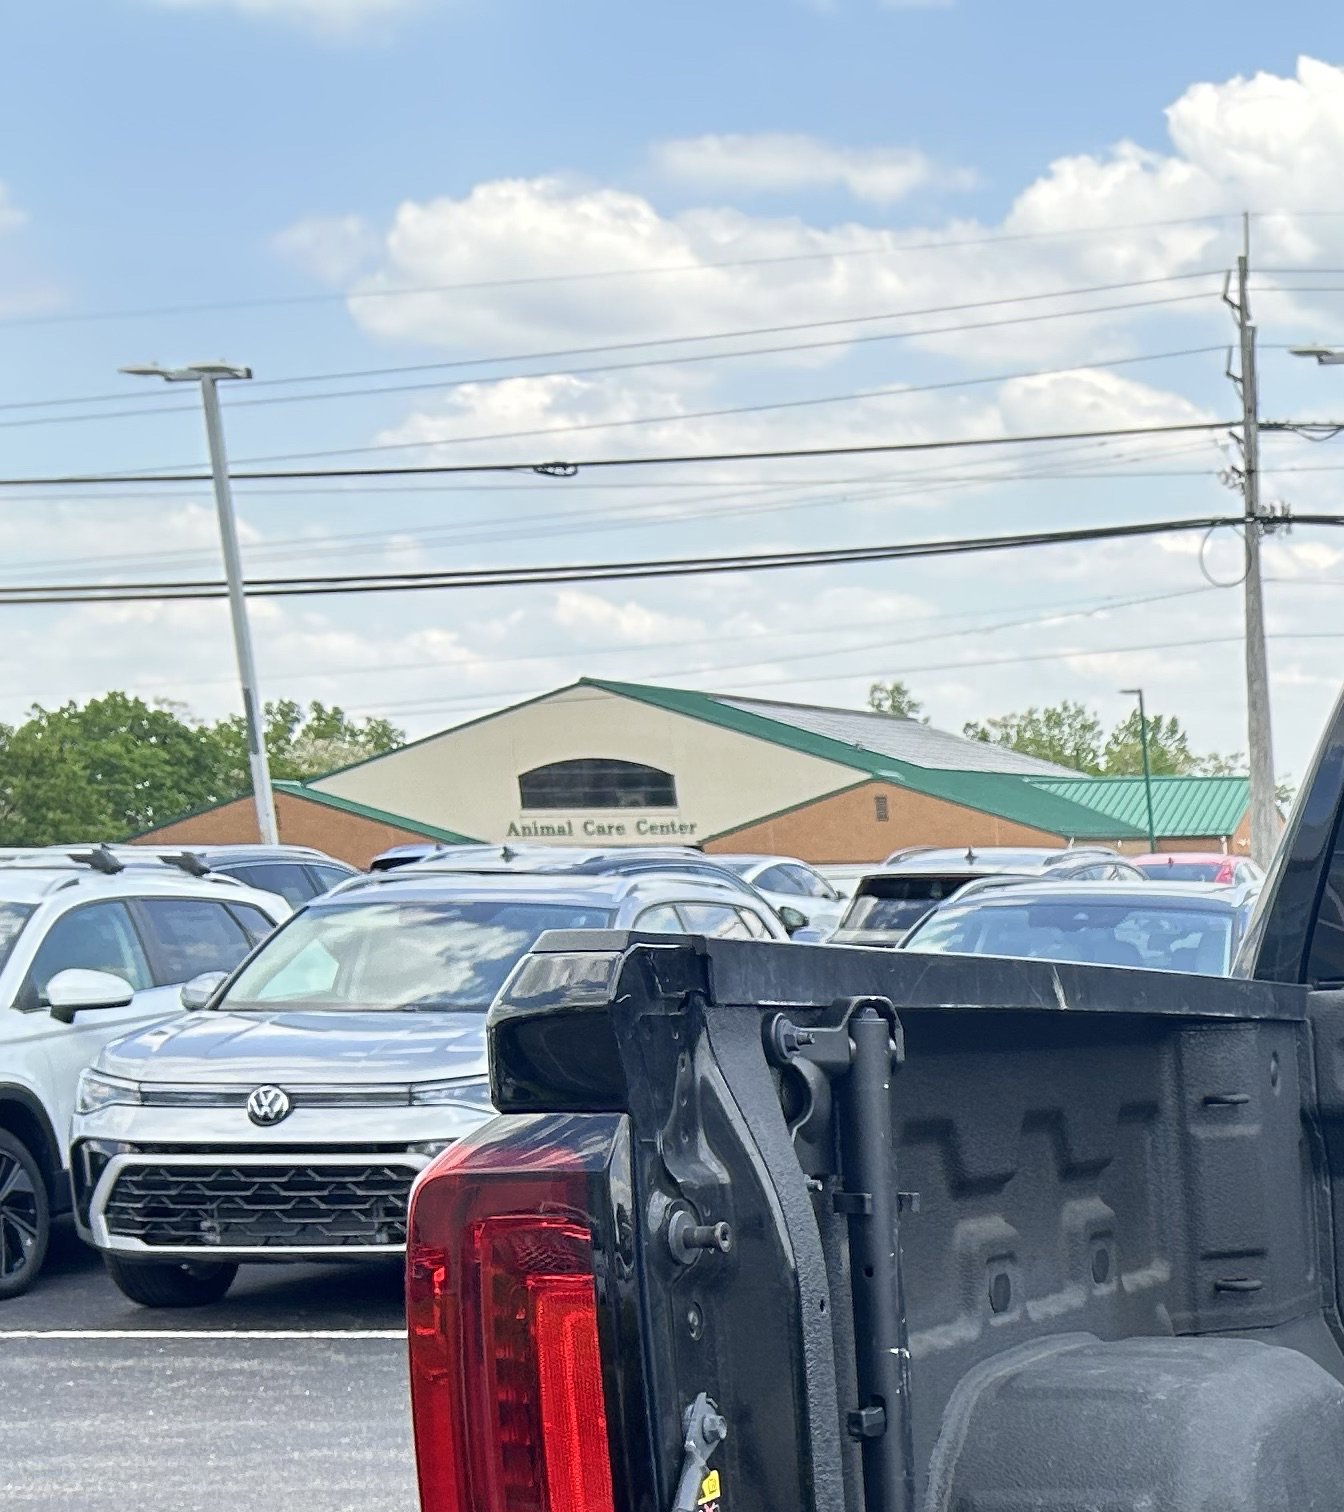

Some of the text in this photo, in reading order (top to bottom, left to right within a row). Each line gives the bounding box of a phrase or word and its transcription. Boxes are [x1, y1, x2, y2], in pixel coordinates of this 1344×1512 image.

[506, 818, 698, 837] Animal Care Center
[248, 1085, 289, 1123] VW
